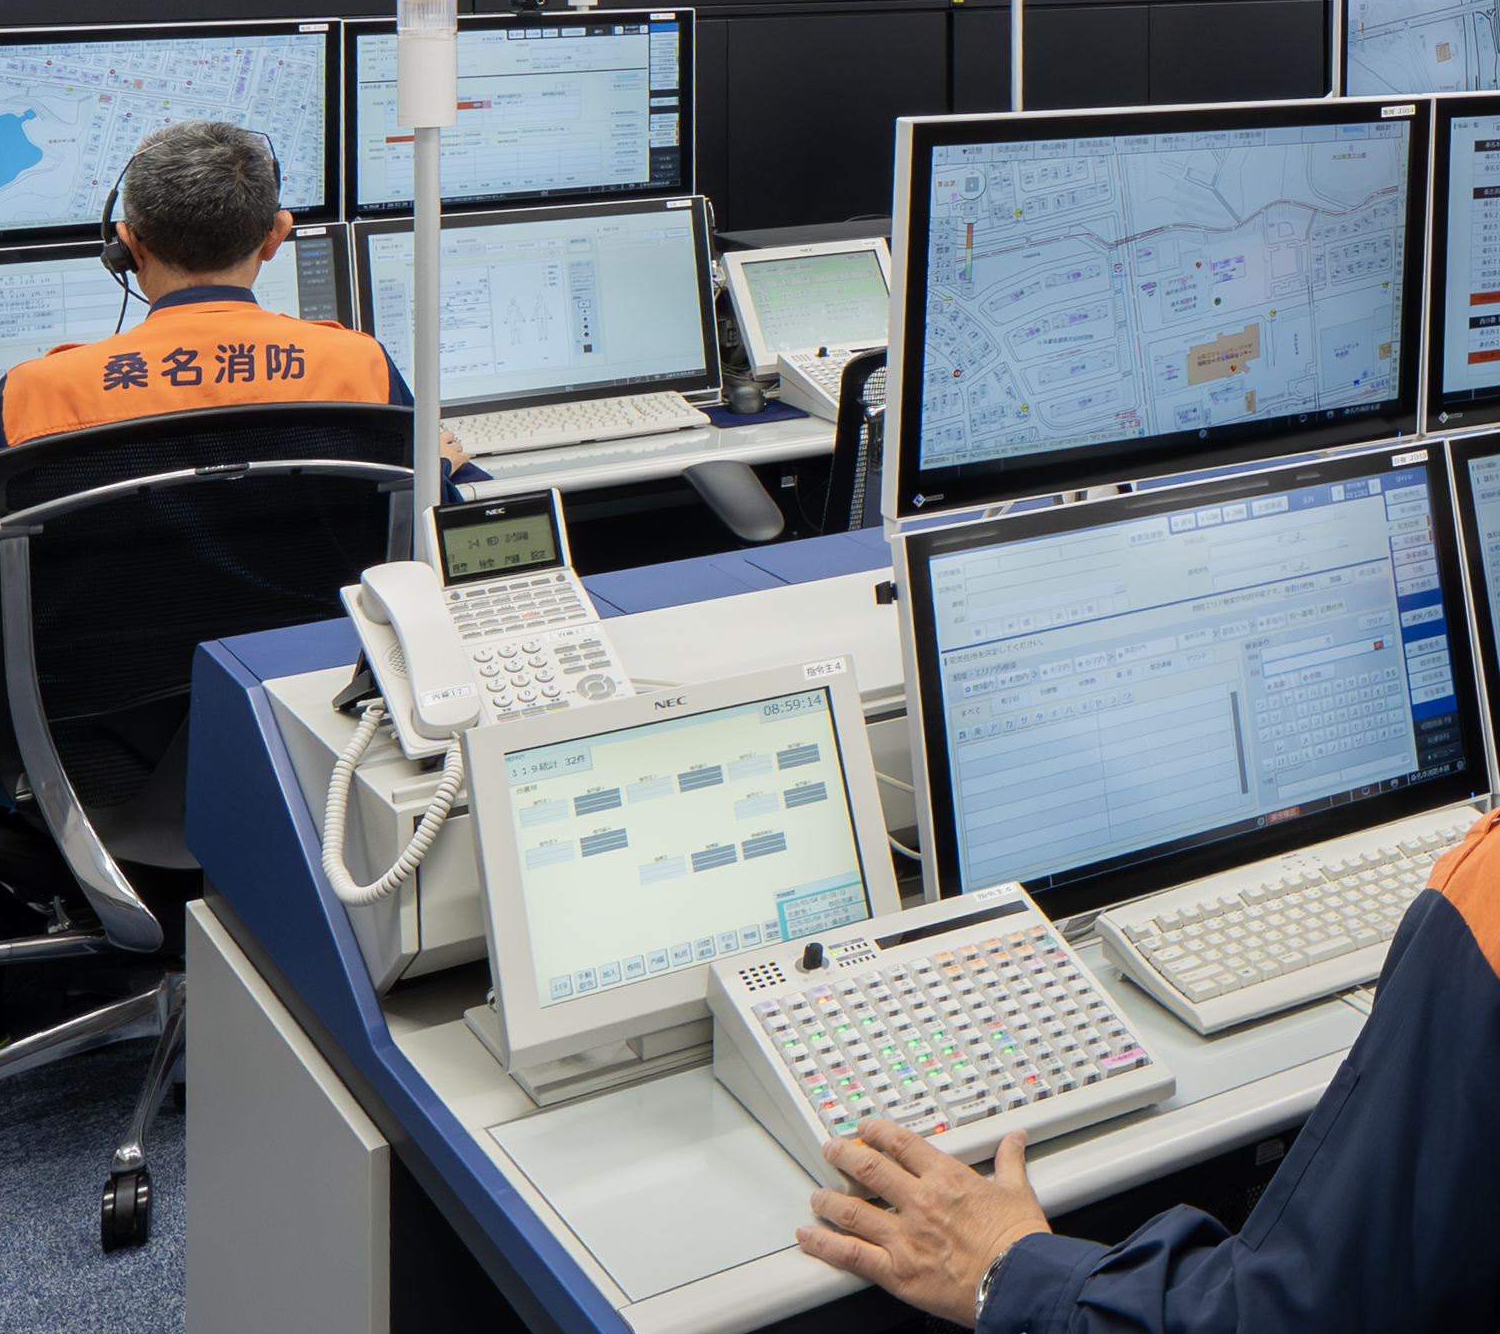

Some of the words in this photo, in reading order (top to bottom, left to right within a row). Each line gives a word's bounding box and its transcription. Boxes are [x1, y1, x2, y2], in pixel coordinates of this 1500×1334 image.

[103, 344, 305, 391] 桑名消防
[486, 507, 505, 515] NEC
[654, 696, 687, 709] NEC
[763, 695, 821, 716] 08:59:14
